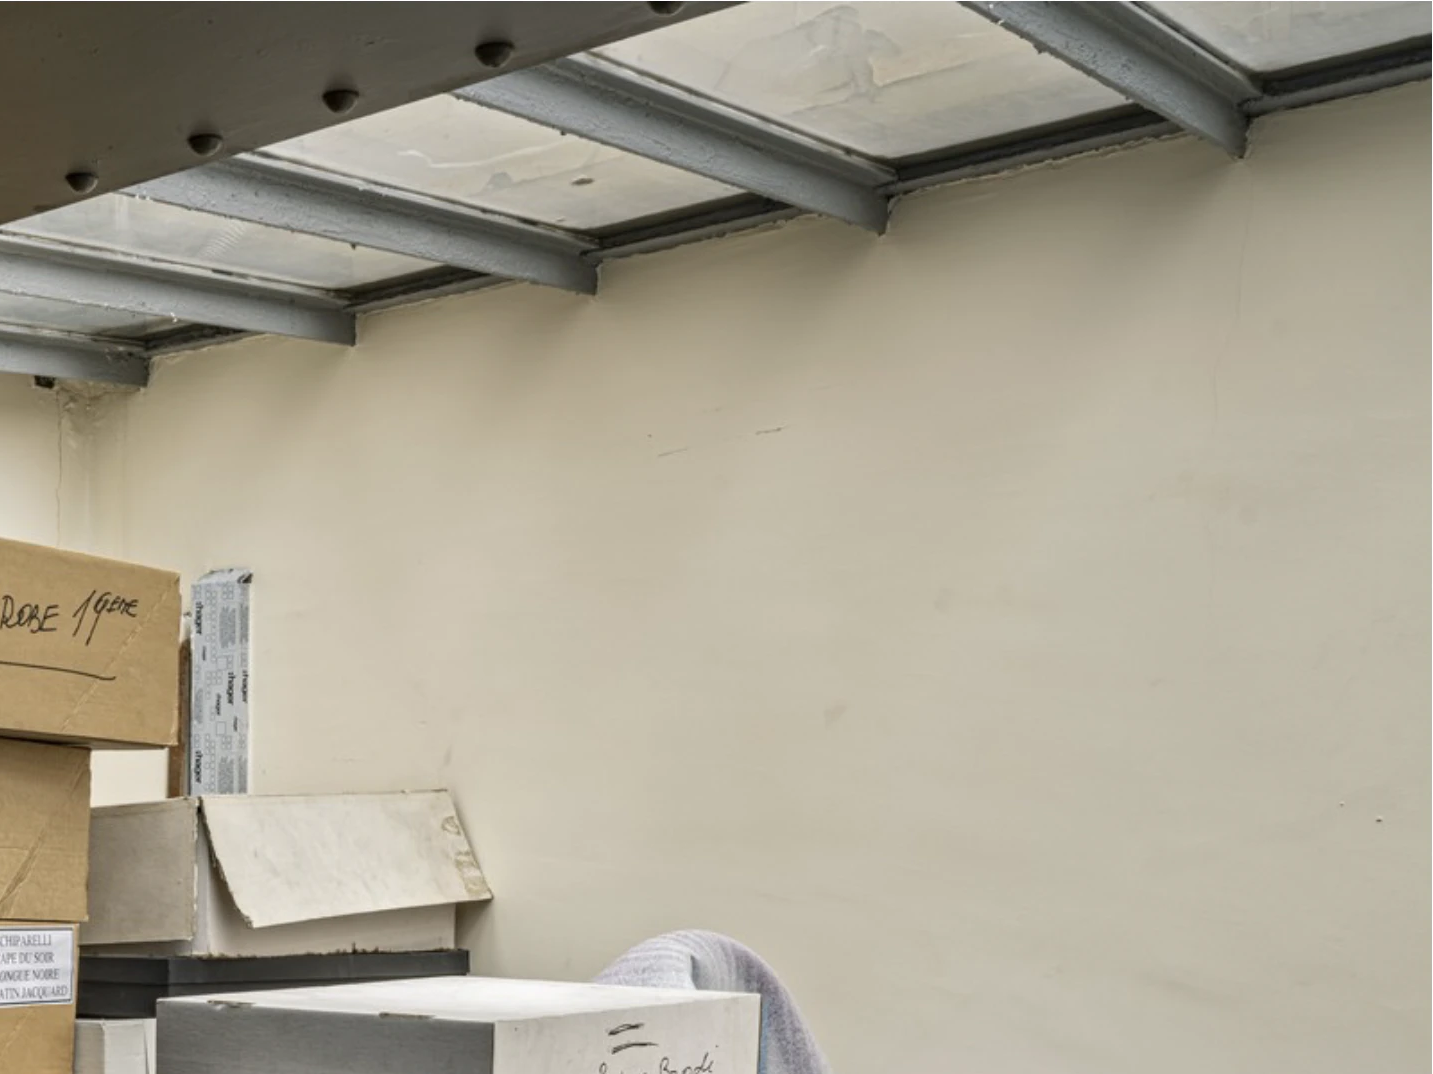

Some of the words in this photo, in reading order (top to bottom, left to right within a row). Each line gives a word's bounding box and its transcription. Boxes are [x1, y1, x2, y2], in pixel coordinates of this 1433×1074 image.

[19, 951, 32, 964] DU
[33, 951, 55, 964] SOIR
[32, 968, 60, 981] NOIRE
[21, 984, 68, 999] JACQUARD
